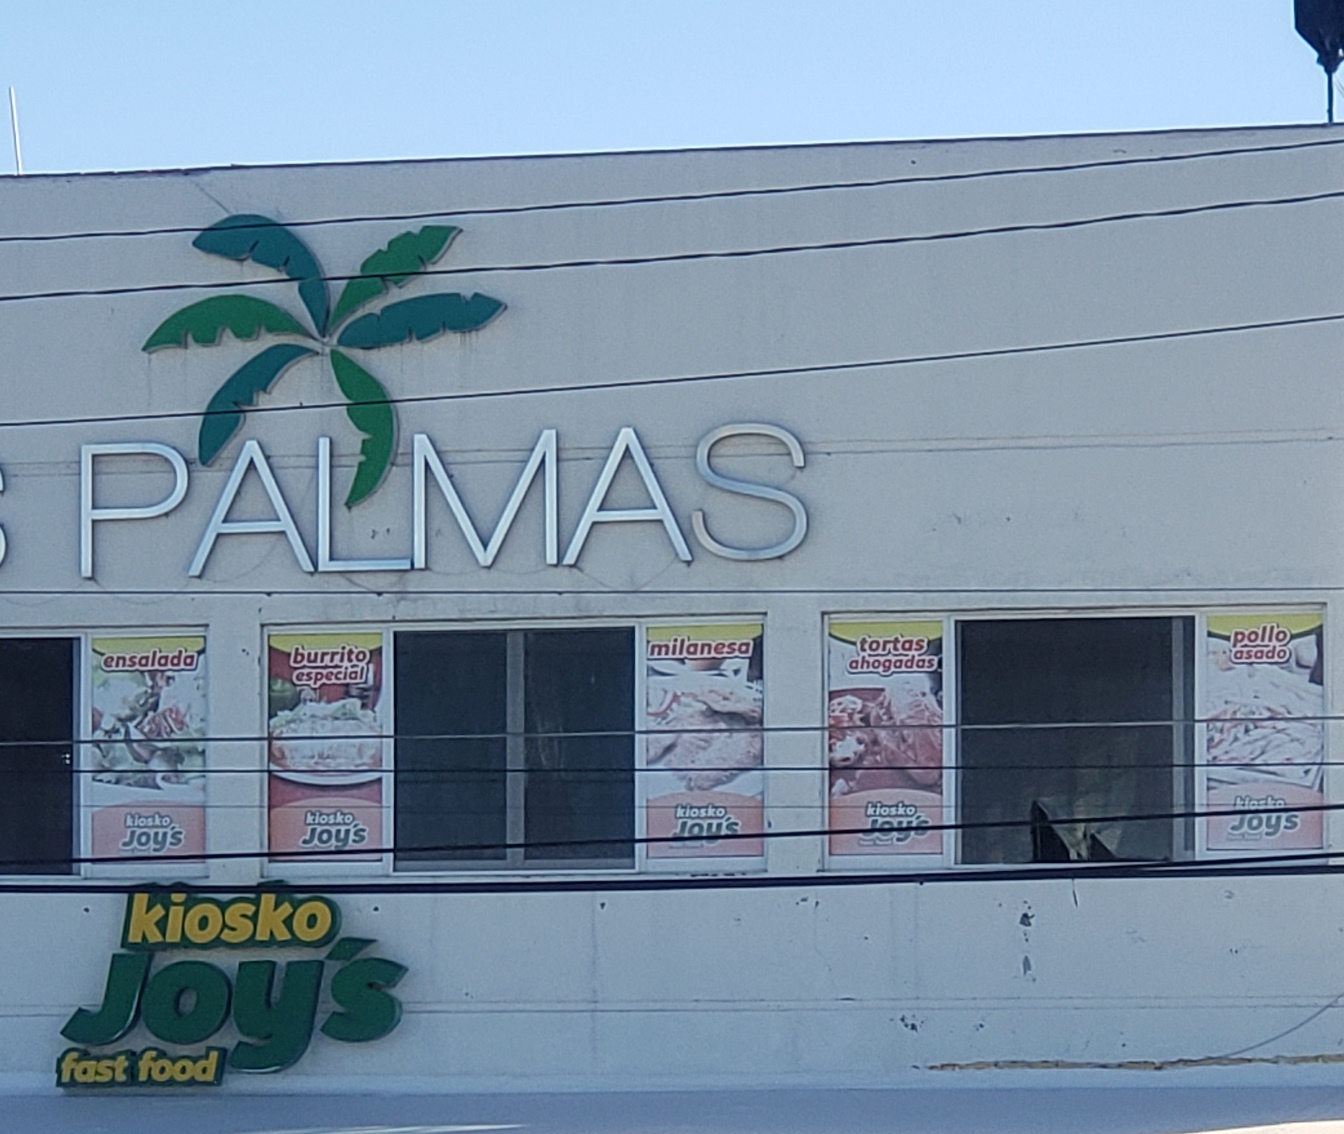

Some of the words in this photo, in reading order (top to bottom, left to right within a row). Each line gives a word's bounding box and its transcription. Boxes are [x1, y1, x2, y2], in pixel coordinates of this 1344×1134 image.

[81, 423, 808, 578] PALMAS
[649, 639, 752, 658] milanesa
[859, 636, 927, 654] tortas
[1232, 627, 1288, 648] pollo
[102, 649, 196, 671] ensalada
[291, 646, 367, 668] burrito
[848, 655, 936, 673] ahogadas
[1233, 645, 1288, 662] asado
[295, 666, 365, 684] especial
[126, 814, 170, 827] kiosko
[306, 811, 354, 826] kiosko
[676, 805, 725, 819] kiosko
[867, 803, 916, 817] kiosko
[301, 822, 367, 847] Joy's
[672, 816, 739, 843] Joy's
[865, 815, 930, 841] Joy's
[1231, 810, 1299, 838] Joys
[122, 824, 184, 851] Joy's
[127, 889, 332, 943] kiosko
[60, 937, 408, 1074] Joy's
[61, 1051, 128, 1082] fast
[138, 1050, 218, 1082] food
